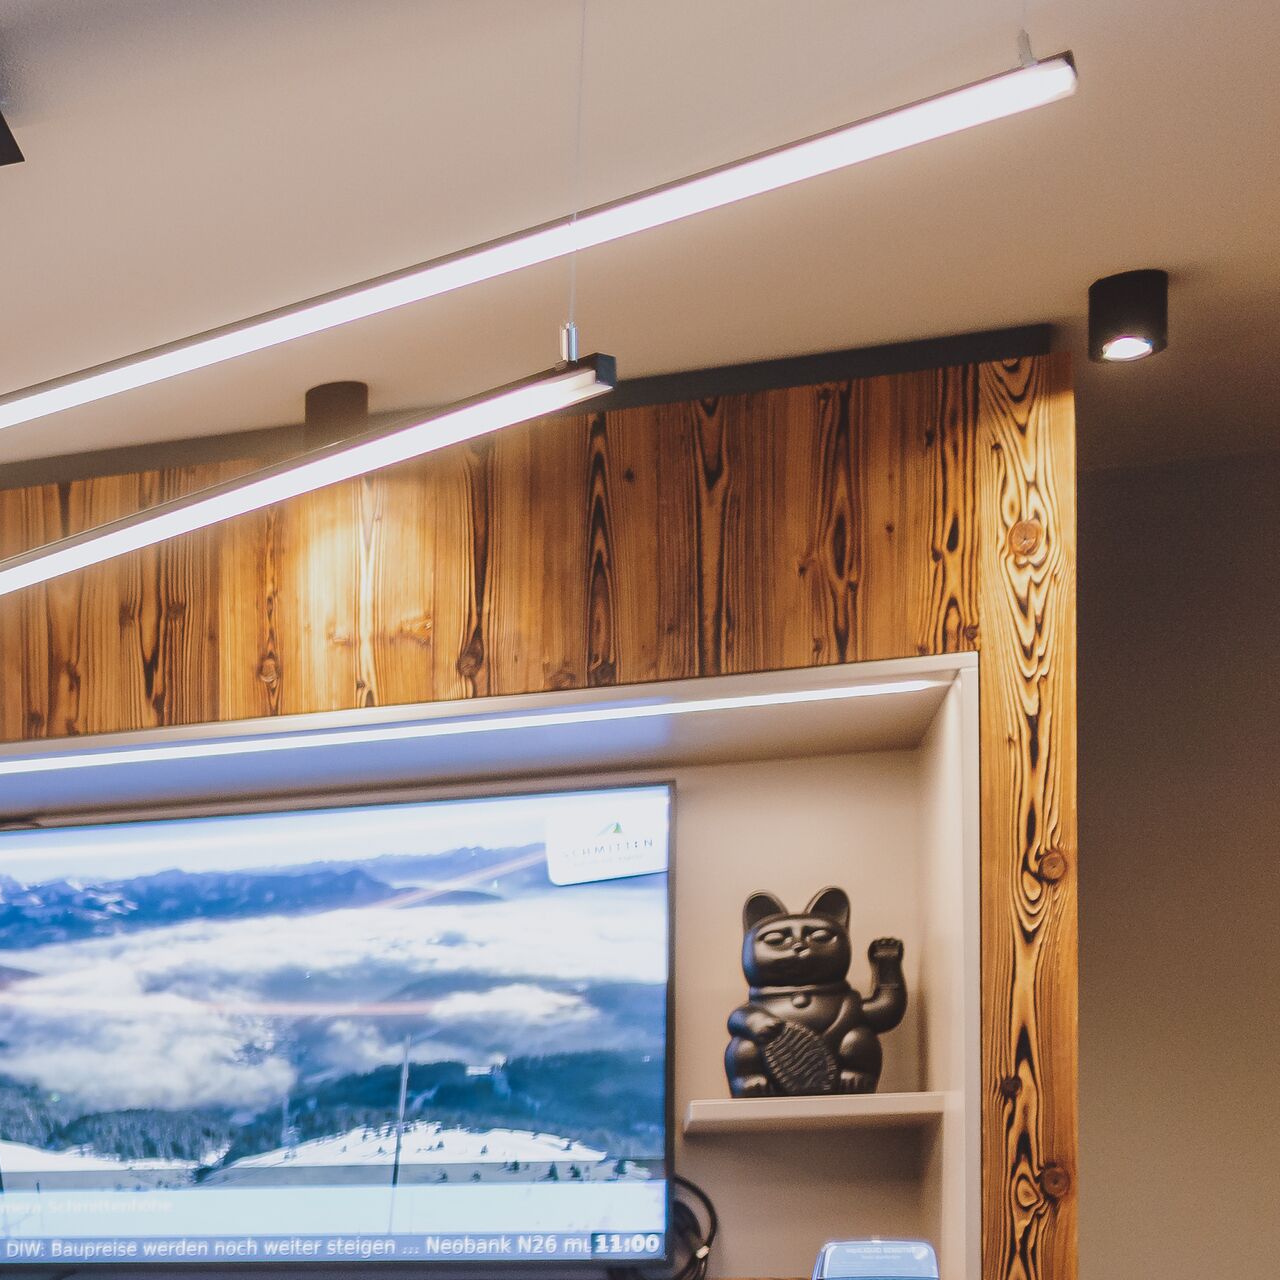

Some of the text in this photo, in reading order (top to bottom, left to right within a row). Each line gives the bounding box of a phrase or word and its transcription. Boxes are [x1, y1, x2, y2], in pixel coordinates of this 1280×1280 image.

[6, 1239, 46, 1257] DIW:
[51, 1237, 137, 1261] Baupreise
[143, 1237, 208, 1257] werden
[214, 1237, 257, 1256] noch
[263, 1236, 322, 1256] weiter
[327, 1236, 396, 1259] steigen
[425, 1235, 512, 1255] Neobank
[517, 1234, 557, 1254] N26
[594, 1233, 660, 1254] 11:00
